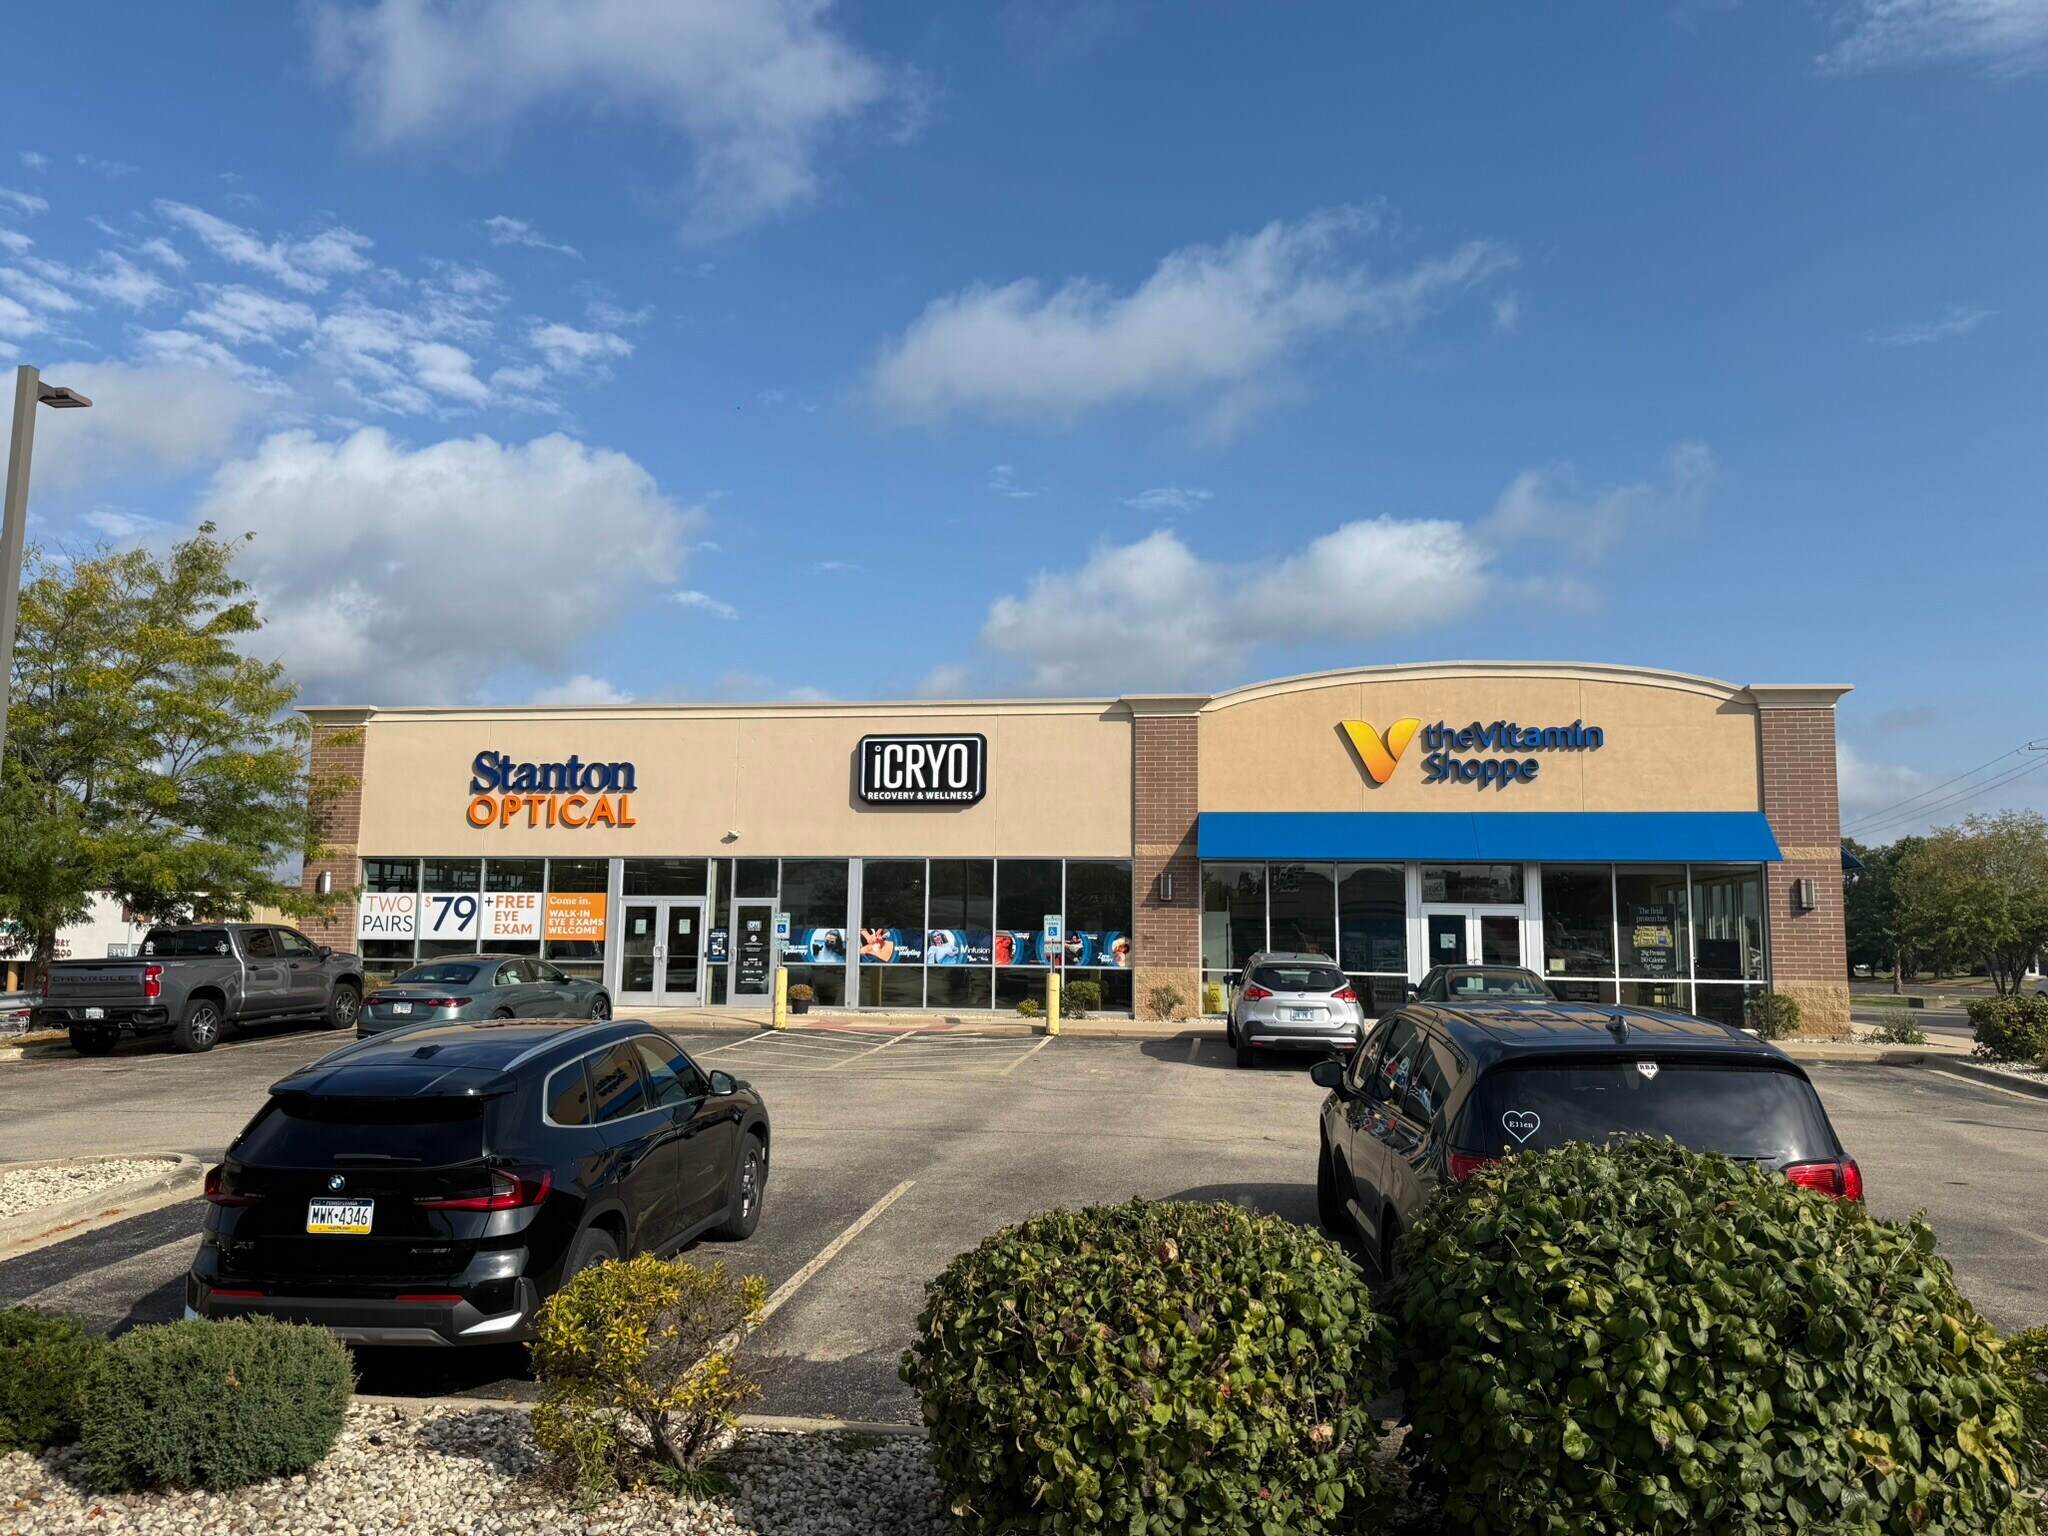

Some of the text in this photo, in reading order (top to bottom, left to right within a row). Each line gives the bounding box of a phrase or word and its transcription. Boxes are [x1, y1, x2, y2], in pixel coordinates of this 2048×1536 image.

[472, 750, 638, 791] Stanton
[874, 743, 968, 789] iCRYO
[1427, 752, 1540, 786] Shoppe
[867, 791, 973, 800] RECOVERY & WELLNESS
[468, 795, 637, 825] OPTICAL
[366, 895, 413, 913] TWO
[549, 896, 591, 906] Come in.
[494, 910, 519, 922] EYE
[549, 910, 591, 918] WALK-IN
[362, 914, 413, 933] PAIRS
[549, 918, 604, 926] EYE EXAMS
[548, 926, 597, 935] WELCOME
[52, 975, 136, 983] CHEVROLET
[1509, 1120, 1534, 1129] Ellen
